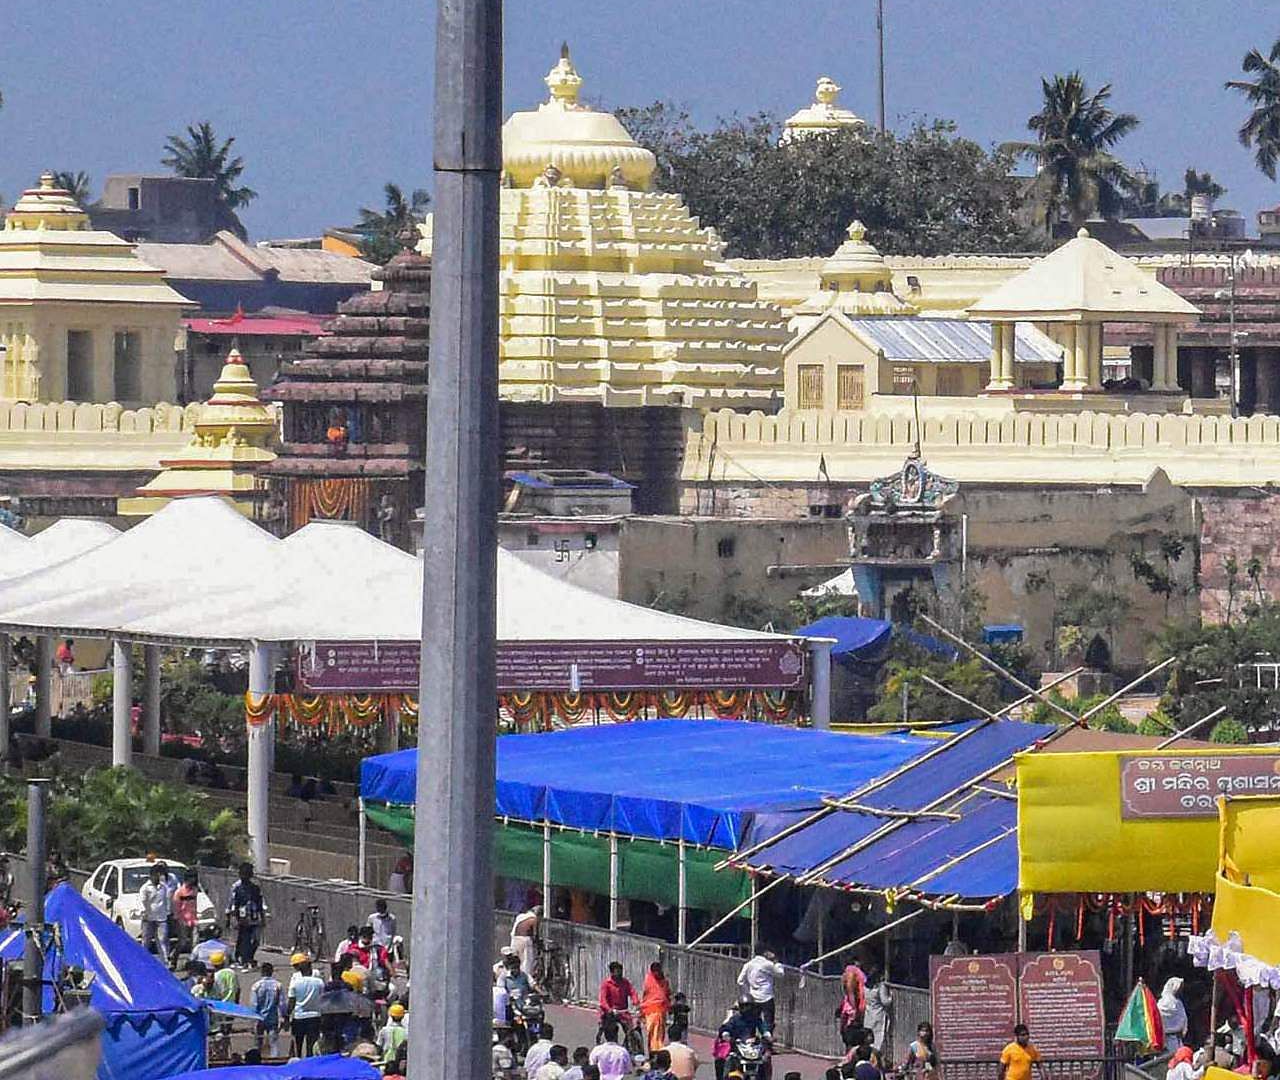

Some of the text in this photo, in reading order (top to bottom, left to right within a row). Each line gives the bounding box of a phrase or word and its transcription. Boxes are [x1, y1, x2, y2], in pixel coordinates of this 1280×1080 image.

[1137, 759, 1222, 773] ଜୟ ଜଗନ୍ନାଥ
[1134, 776, 1156, 794] ଶ୍ରୀ
[1162, 773, 1211, 791] ମନ୍ଦିର
